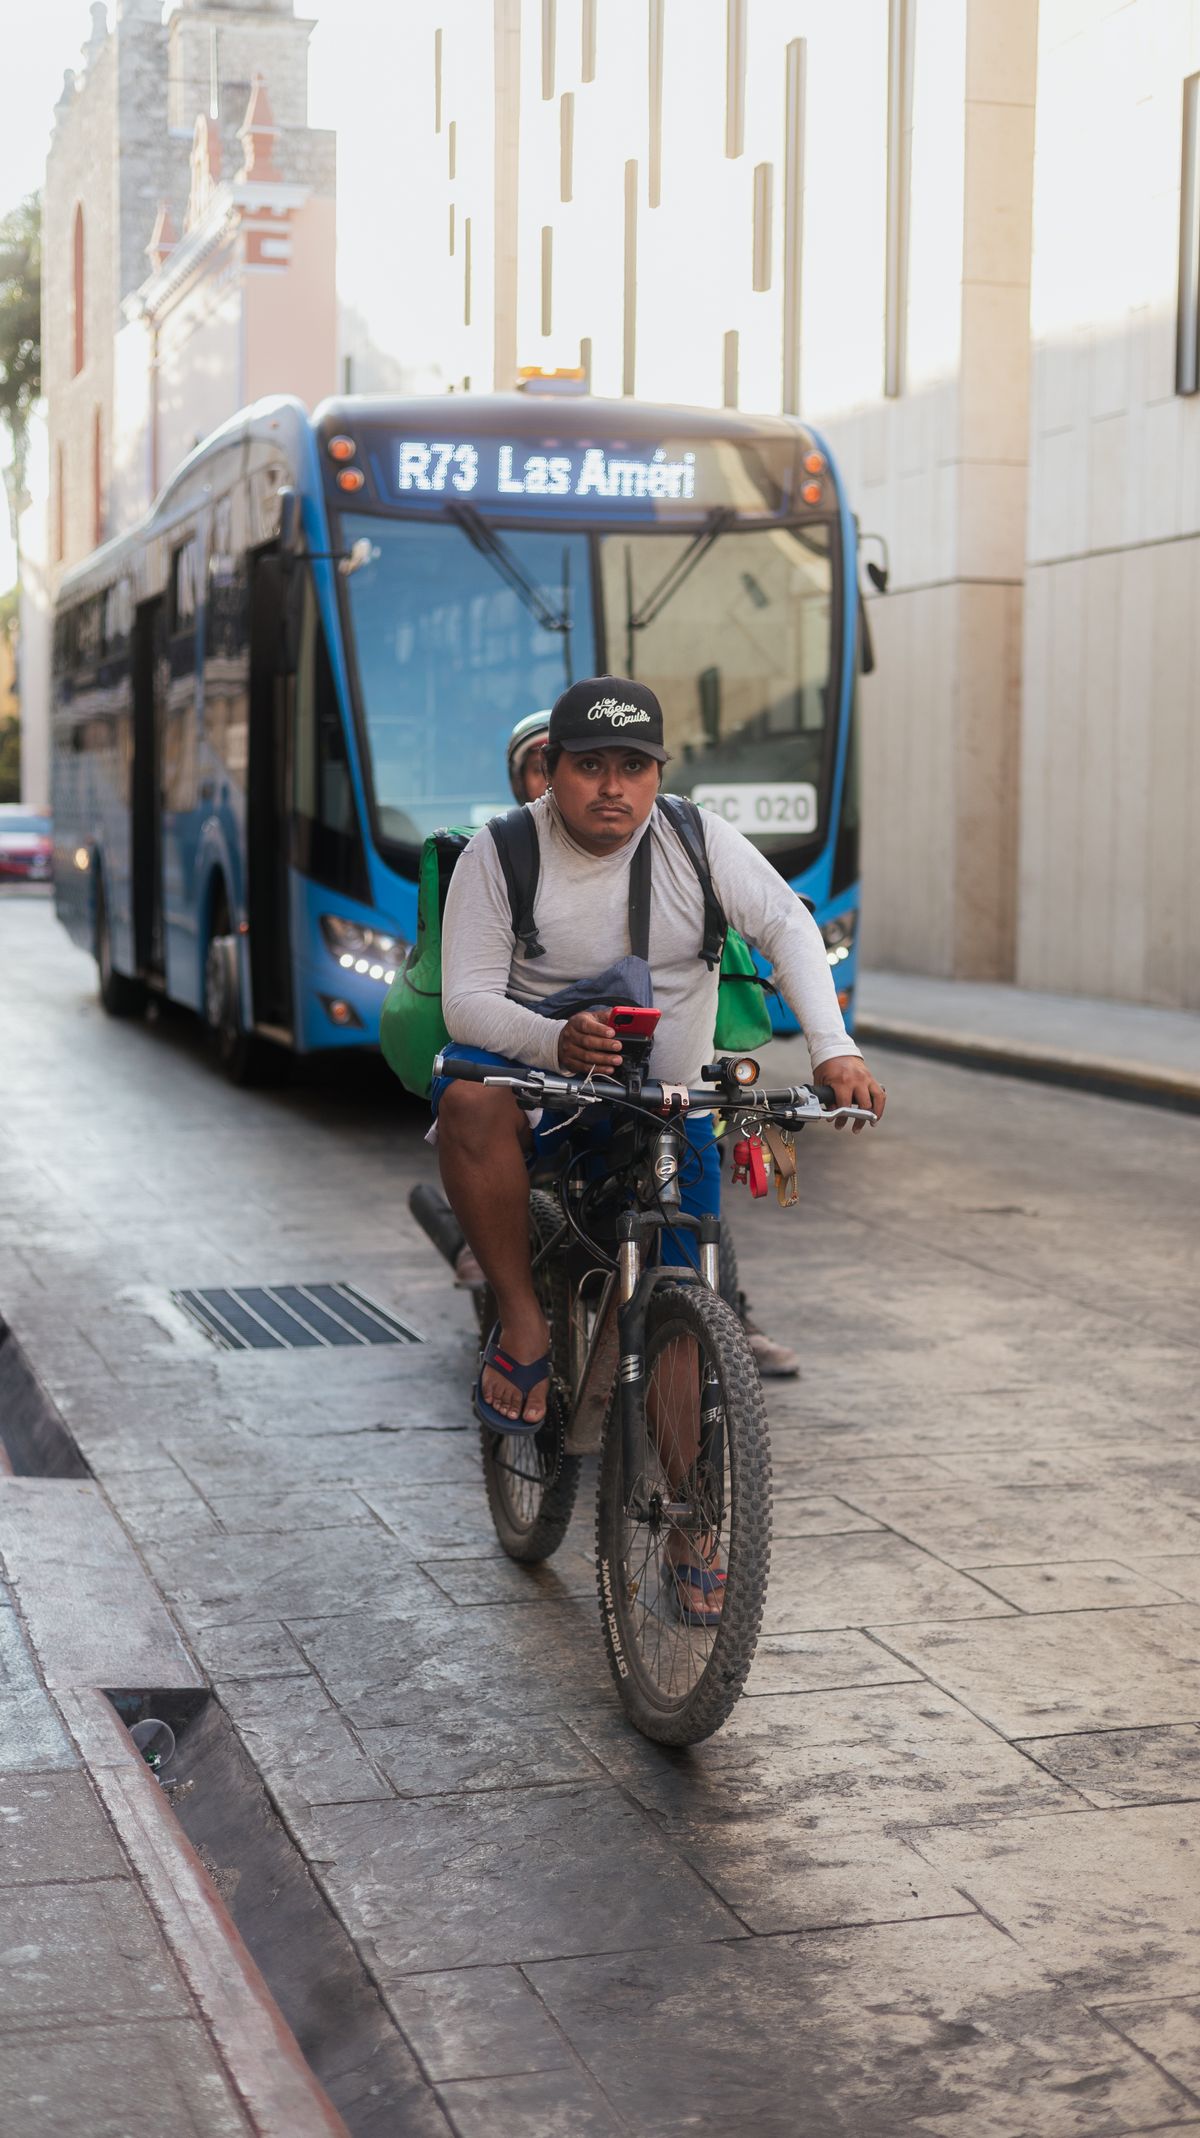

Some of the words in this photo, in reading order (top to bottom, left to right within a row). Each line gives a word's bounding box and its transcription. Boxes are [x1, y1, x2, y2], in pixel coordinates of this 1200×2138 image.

[399, 442, 478, 491] R73
[498, 445, 572, 494] Las
[575, 449, 696, 498] Améri
[587, 701, 637, 720] Angeles
[601, 697, 618, 706] Los
[611, 709, 650, 727] Azules
[755, 795, 810, 822] 020
[602, 1558, 614, 1609] HAWK
[607, 1612, 622, 1653] ROCK
[615, 1654, 629, 1678] CST
